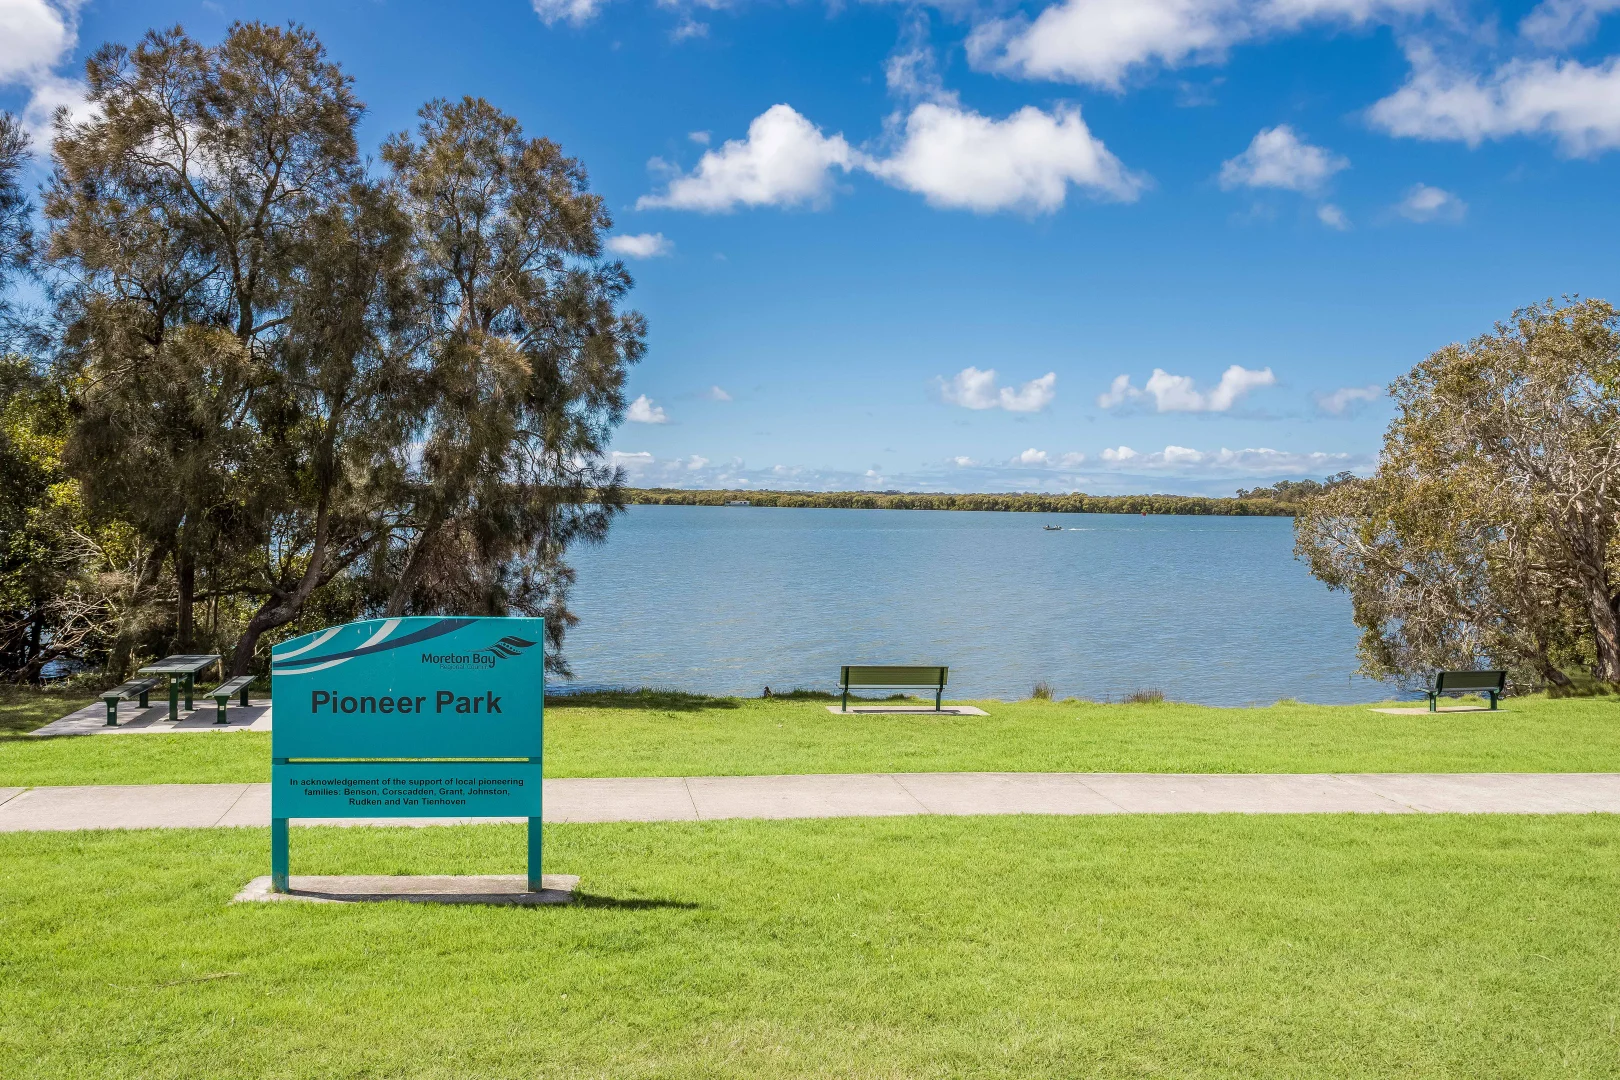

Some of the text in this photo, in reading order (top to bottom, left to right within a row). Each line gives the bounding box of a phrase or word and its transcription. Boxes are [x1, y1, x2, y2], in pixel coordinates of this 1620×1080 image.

[422, 653, 495, 668] Moreton Bay
[311, 691, 502, 713] Pioneer Park
[301, 778, 379, 787] acknowledgement
[409, 778, 442, 787] support
[478, 778, 524, 787] pioneering
[344, 788, 380, 796] Benson,
[382, 788, 436, 796] Corscadden,
[439, 788, 465, 796] Grant,
[467, 788, 510, 796] Johnston,
